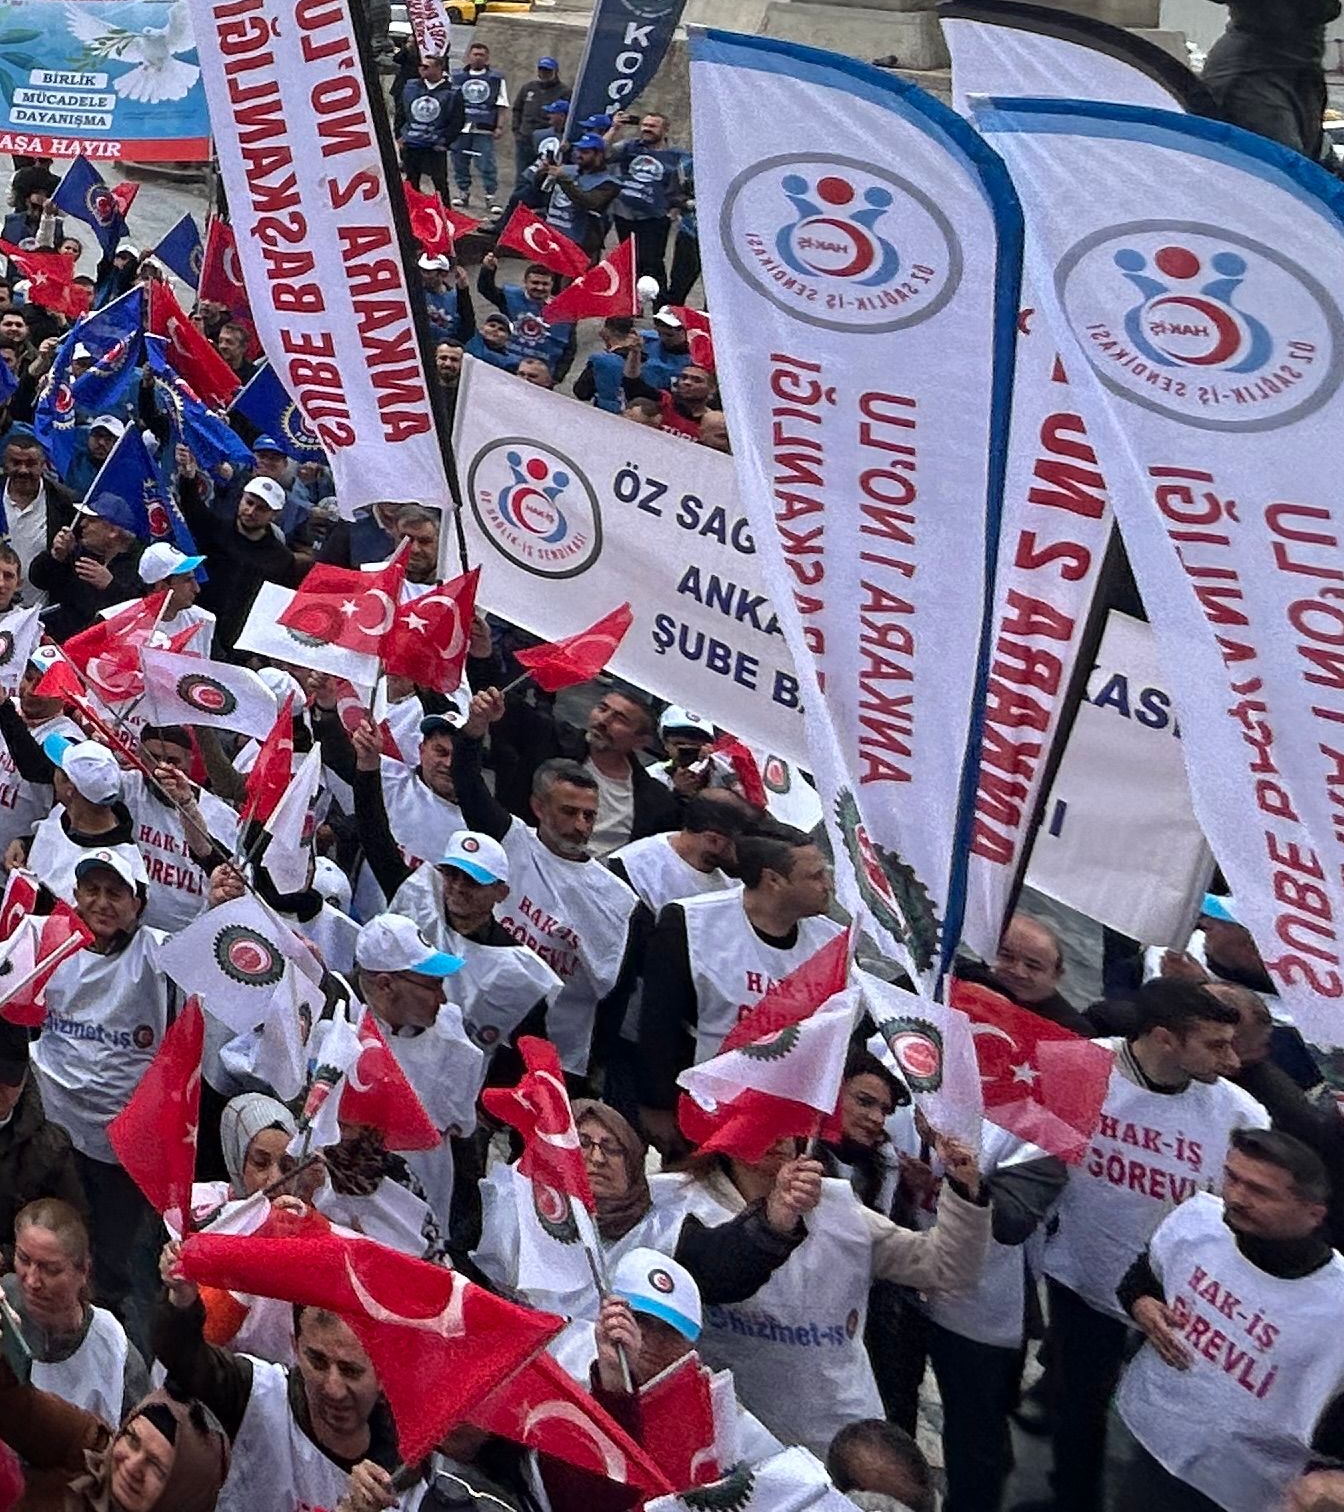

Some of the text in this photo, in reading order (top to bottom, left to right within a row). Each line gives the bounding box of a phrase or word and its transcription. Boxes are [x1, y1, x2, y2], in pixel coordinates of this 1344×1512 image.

[42, 71, 96, 86] BİRLİK
[22, 90, 108, 108] MÜCADELE
[16, 109, 107, 128] DAYANIŞMA
[49, 140, 122, 156] HAYIR
[612, 461, 669, 518] ÖZ
[652, 613, 759, 691] ŞUBE
[1099, 1112, 1203, 1174] HAK-İŞ
[1188, 1265, 1281, 1353] HAK-İŞ
